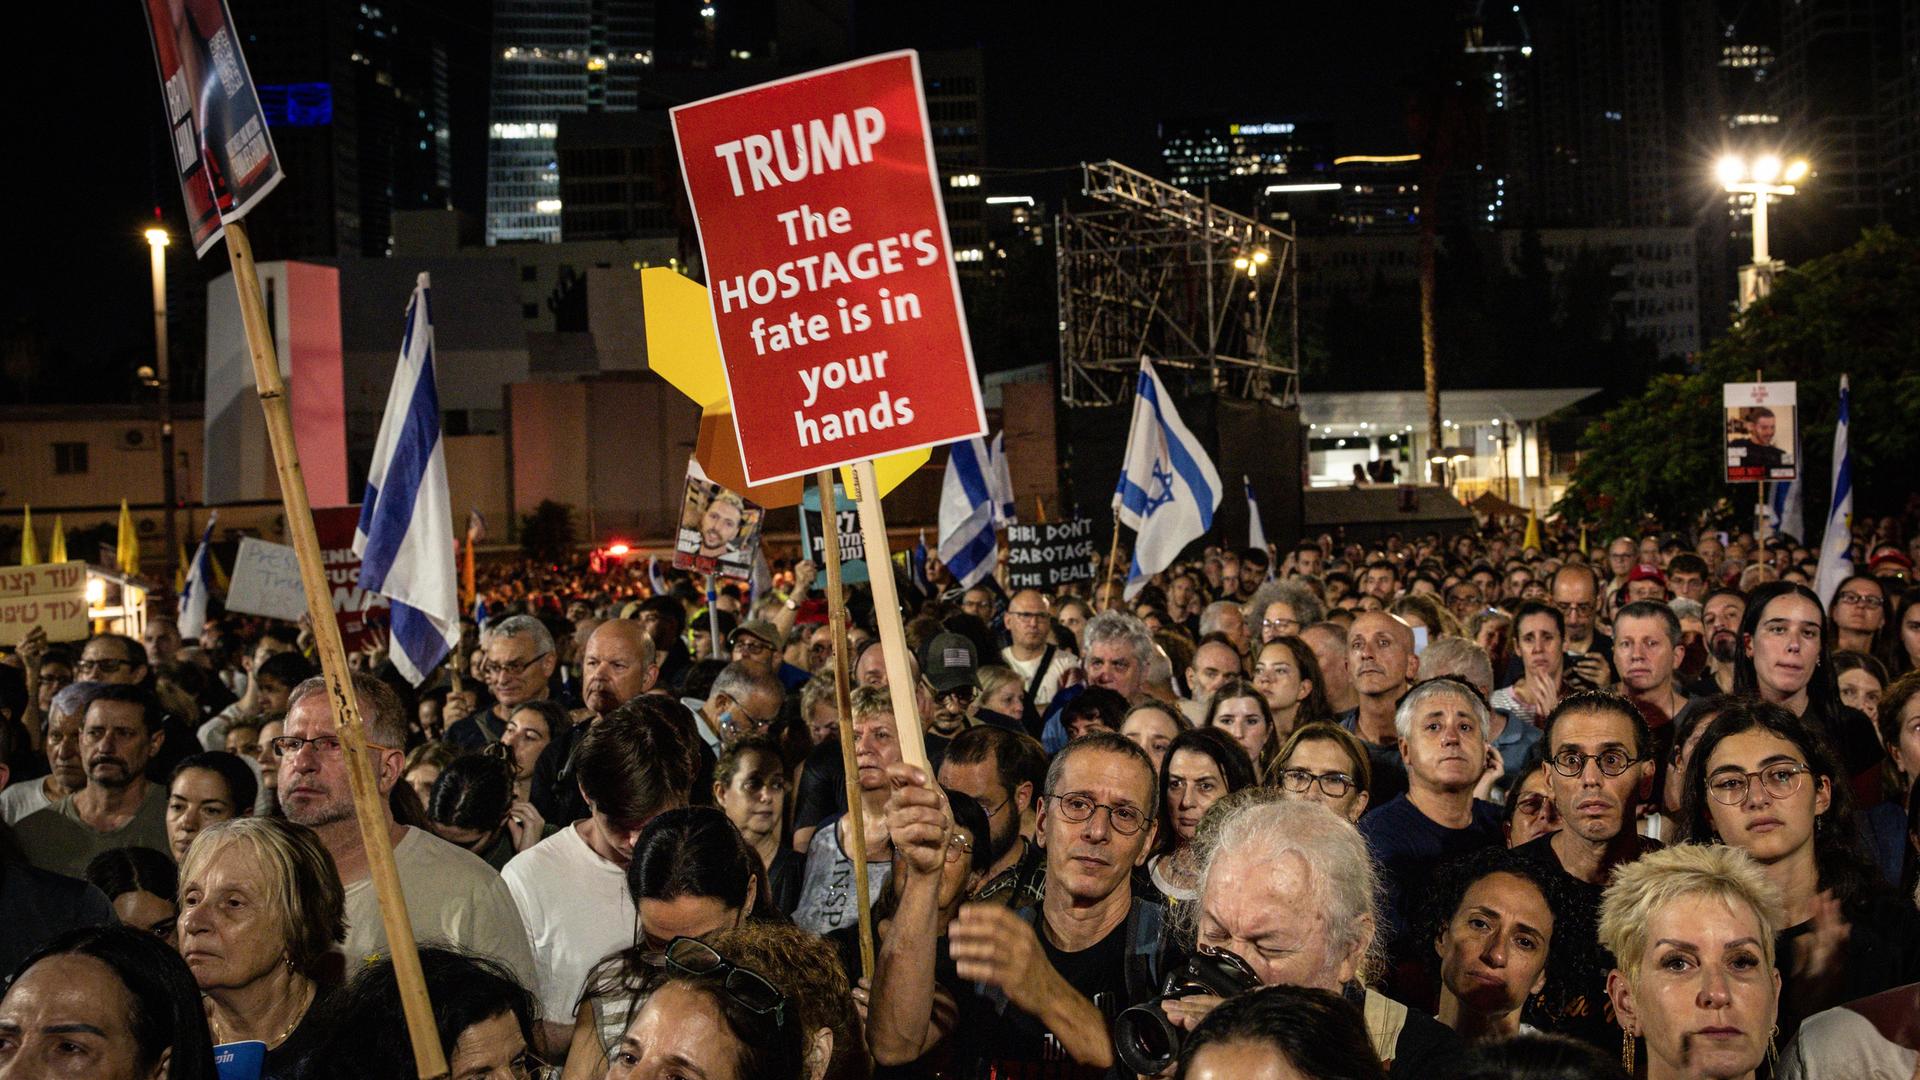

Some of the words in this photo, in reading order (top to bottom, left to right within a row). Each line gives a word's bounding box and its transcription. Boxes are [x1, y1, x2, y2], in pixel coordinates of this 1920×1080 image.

[715, 107, 887, 197] TRUMP
[777, 204, 852, 246] The
[719, 229, 939, 313] HOSTAGE'S
[750, 311, 830, 355] fate
[837, 297, 872, 335] is
[879, 287, 922, 325] in
[798, 350, 889, 408] your
[794, 391, 915, 447] hands
[1008, 525, 1041, 545] BIBI,
[1009, 541, 1093, 564] SABOTAGE
[1011, 573, 1042, 586] THE
[1049, 562, 1095, 584] DEAL!
[0, 602, 38, 624] טיפ
